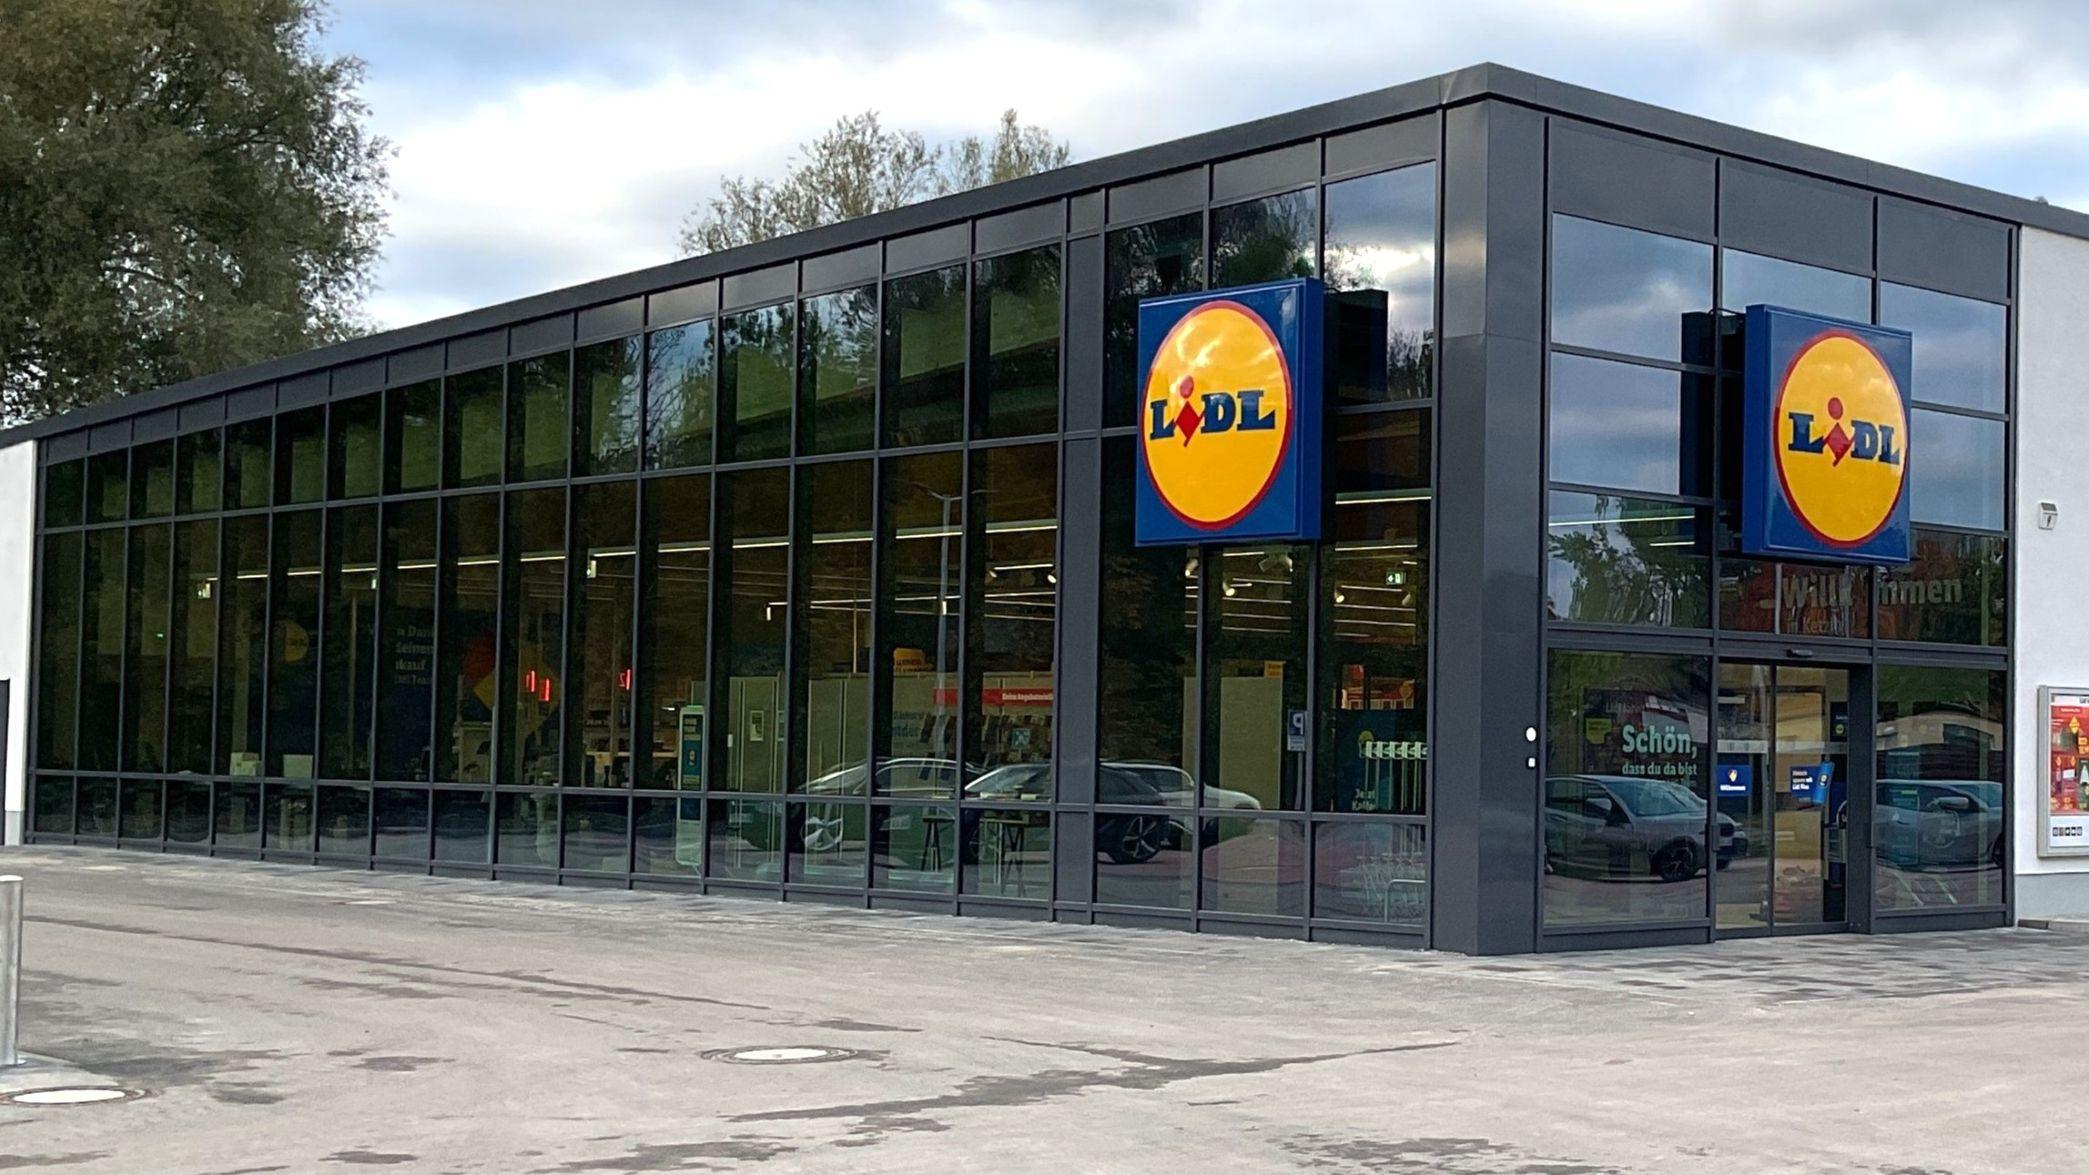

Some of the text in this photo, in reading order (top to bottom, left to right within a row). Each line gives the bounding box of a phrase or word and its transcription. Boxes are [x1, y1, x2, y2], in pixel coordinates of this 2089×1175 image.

[1622, 724, 1697, 759] Schön,
[1622, 761, 1645, 775] dass
[1647, 761, 1661, 775] du
[1663, 761, 1677, 775] da
